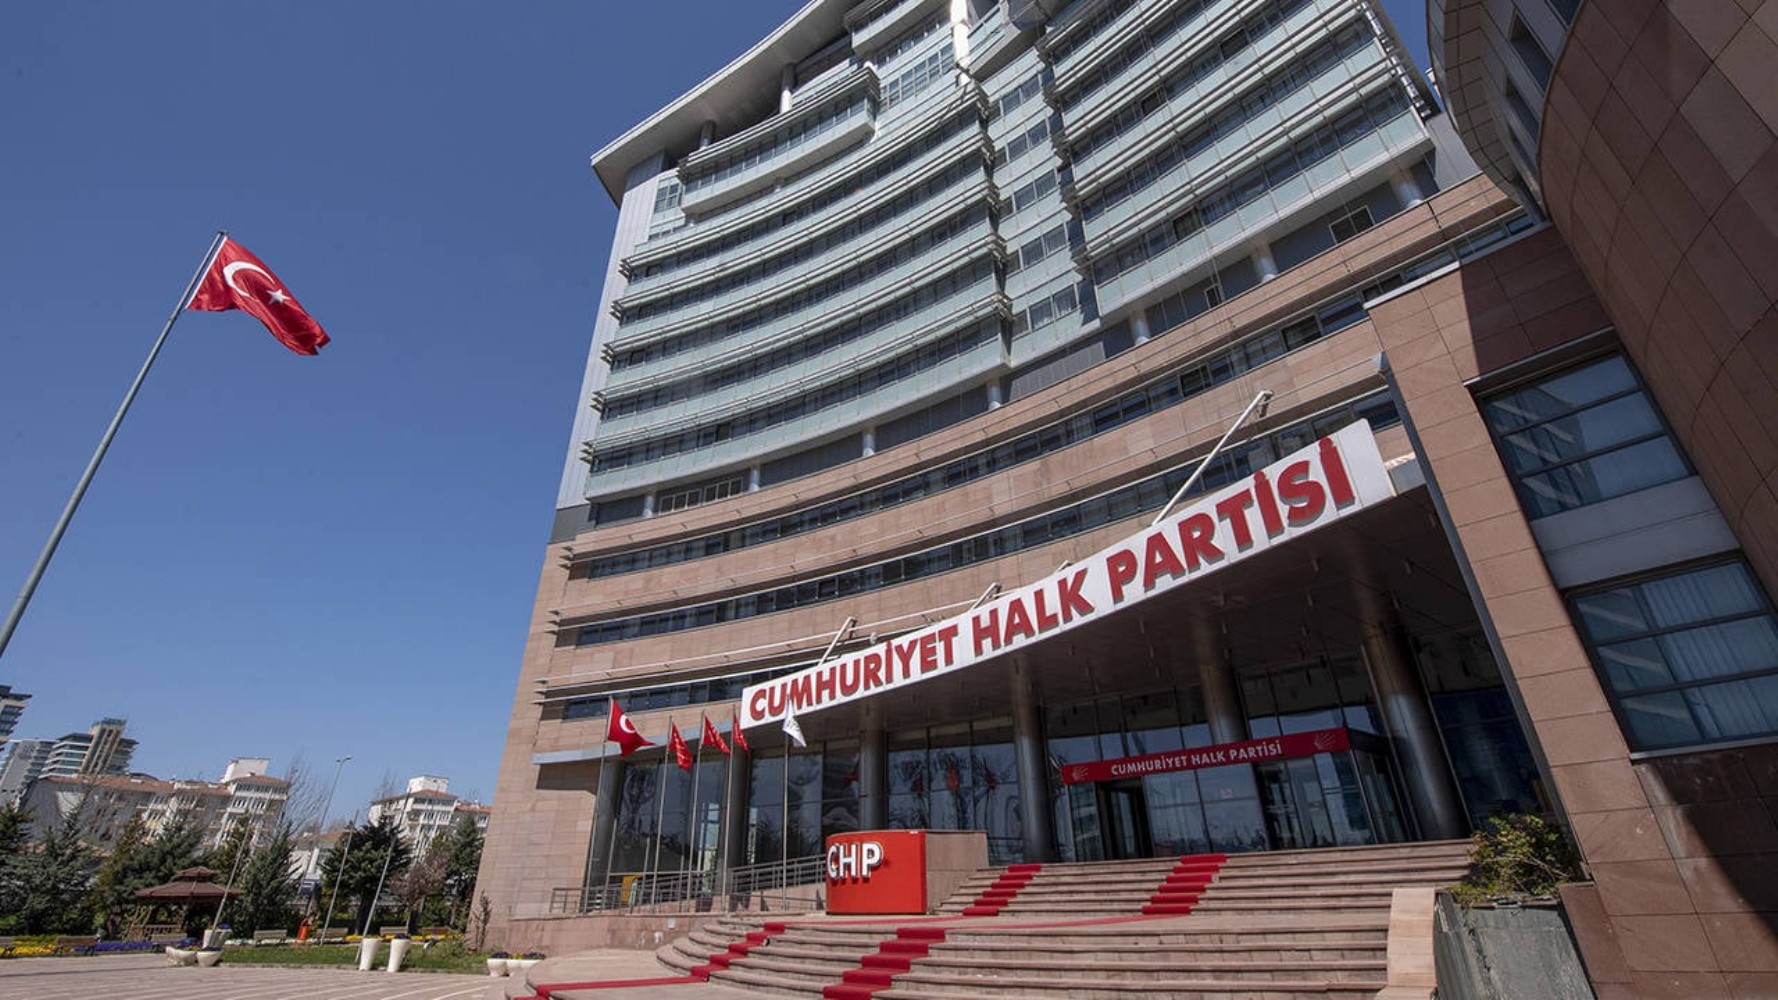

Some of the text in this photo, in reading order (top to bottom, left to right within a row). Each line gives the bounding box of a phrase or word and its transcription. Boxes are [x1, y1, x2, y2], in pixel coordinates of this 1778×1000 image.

[750, 436, 1355, 721] CUMHURİYET HALK PARTİSİ
[1111, 740, 1283, 776] CUMHURİYET HALK PARTİSİ
[827, 841, 884, 879] CHP
